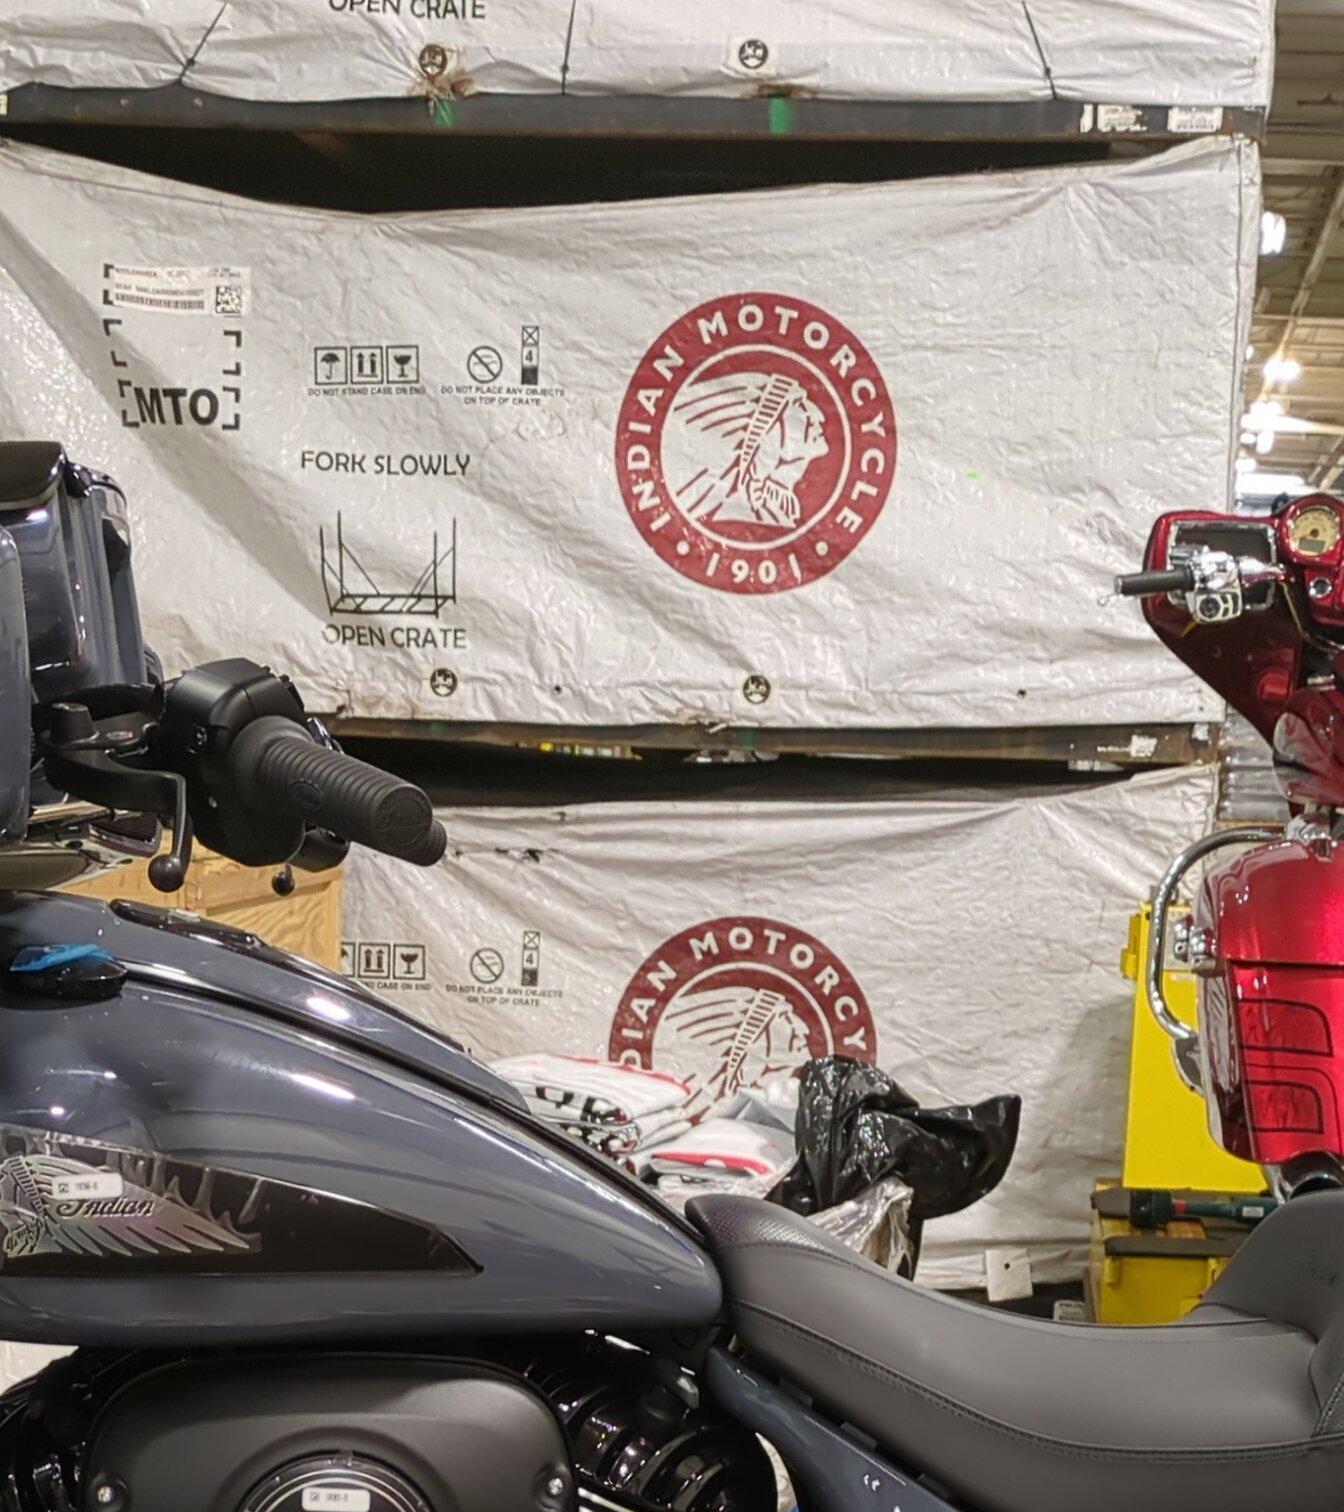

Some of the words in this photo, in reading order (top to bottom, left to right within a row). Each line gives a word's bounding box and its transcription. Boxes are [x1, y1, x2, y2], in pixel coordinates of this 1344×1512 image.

[323, 388, 339, 396] NOT
[371, 387, 392, 395] CASE
[441, 386, 453, 394] DO
[456, 386, 472, 394] NOT
[476, 386, 503, 395] PLACE
[506, 387, 523, 395] ANY
[525, 387, 565, 397] OBJECTS
[464, 397, 476, 405] ON
[479, 397, 496, 405] TOP
[498, 397, 509, 405] OF
[513, 397, 541, 406] CRATE
[134, 387, 219, 426] MTO
[627, 347, 687, 532] INDIAN
[697, 305, 886, 534] MOTORCYCLE
[301, 450, 366, 473] FORK
[374, 454, 470, 476] SLOWLY
[705, 553, 802, 584] 1901
[322, 624, 385, 647] OPEN
[391, 627, 467, 649] CRATE
[459, 985, 475, 993] NOT
[478, 985, 504, 994] PLACE
[507, 987, 523, 996] ANY
[482, 996, 498, 1004] TOP
[512, 997, 540, 1006] CRATE
[620, 959, 677, 1069] DIAN
[689, 926, 867, 1051] MOTORCY
[56, 1197, 155, 1220] Indian
